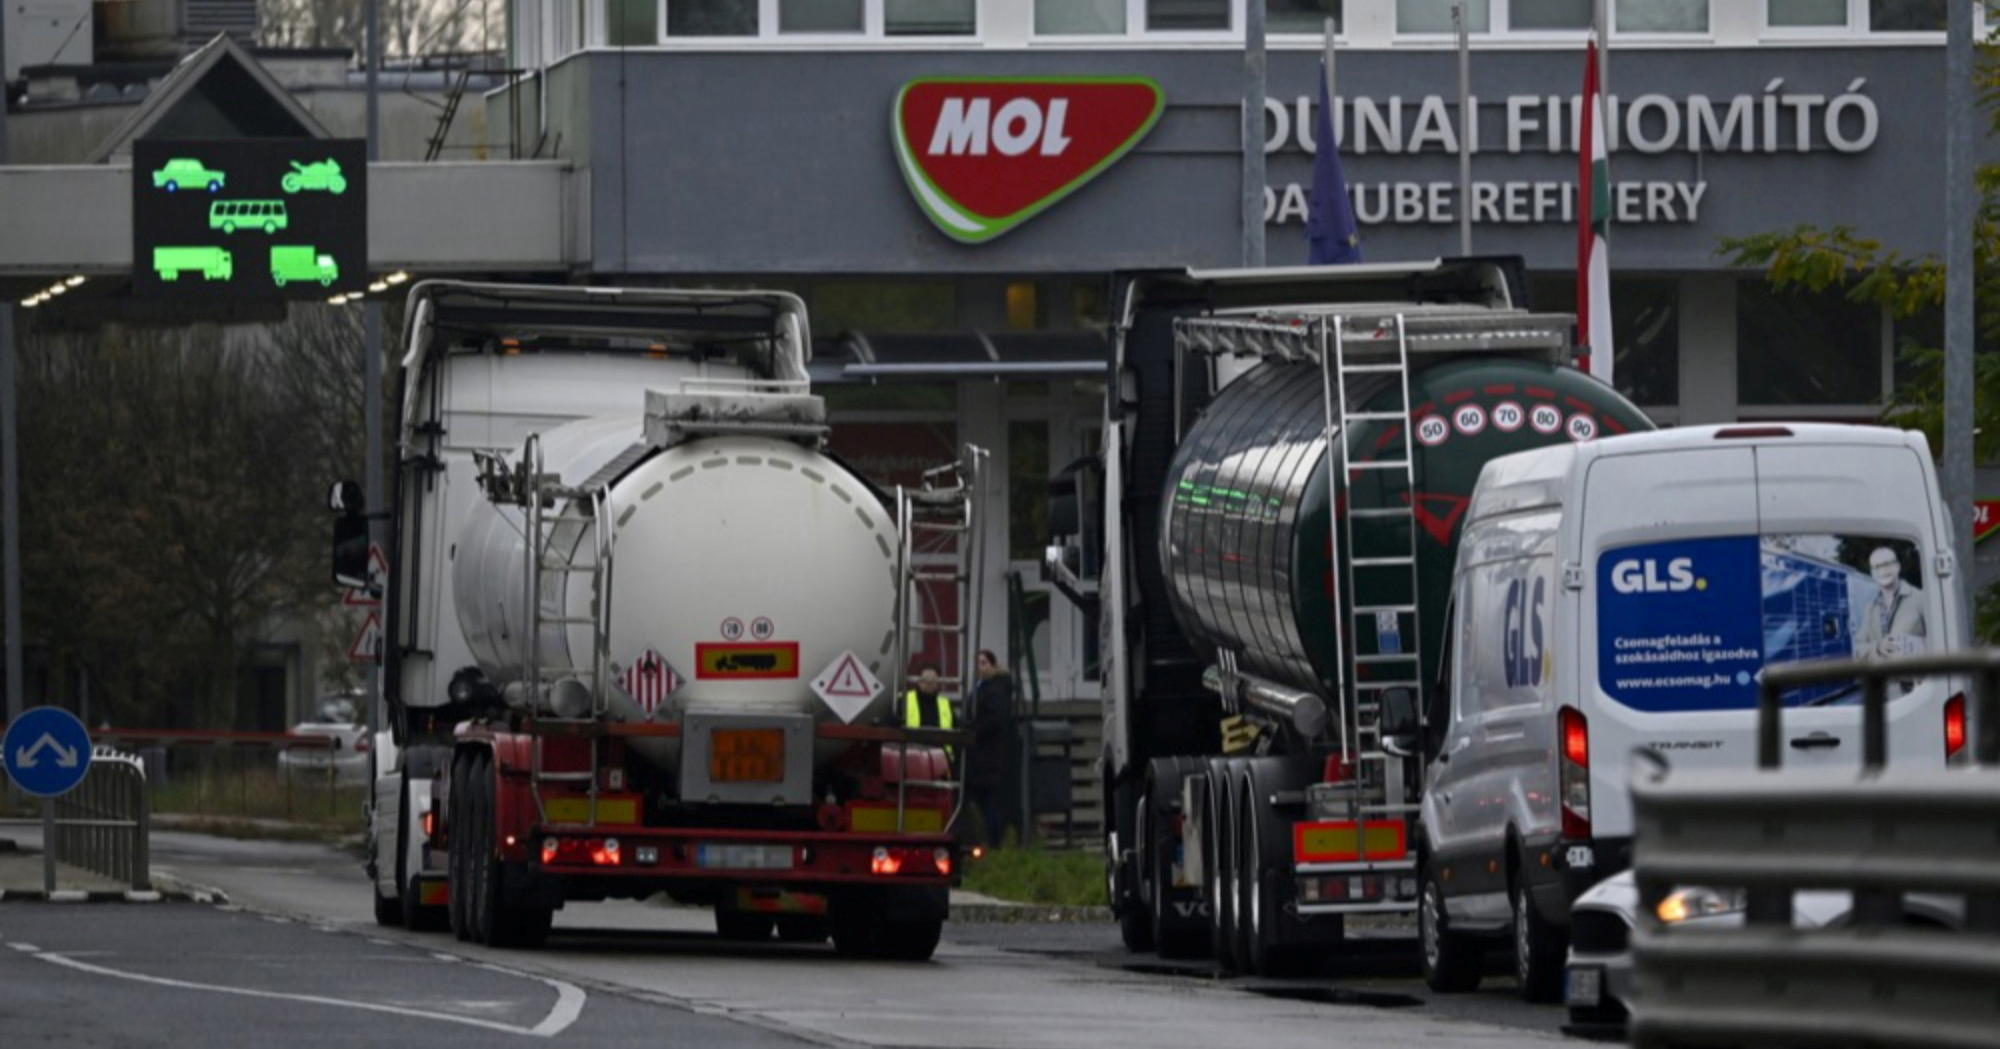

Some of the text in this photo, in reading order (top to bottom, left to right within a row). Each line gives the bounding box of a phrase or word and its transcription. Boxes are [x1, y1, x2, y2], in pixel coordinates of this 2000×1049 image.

[928, 97, 1072, 156] MOL
[1264, 181, 1707, 223] AUBE REFIERY
[1460, 410, 1479, 426] 60
[1498, 408, 1517, 423] 70
[1535, 411, 1555, 426] 80
[1422, 422, 1443, 438] 50
[1572, 420, 1591, 437] 90
[1614, 633, 1722, 650] Csomagfeladás a
[1615, 647, 1759, 664] szokásaidhoz igazodva
[1616, 673, 1731, 689] www.ecsomag.hu
